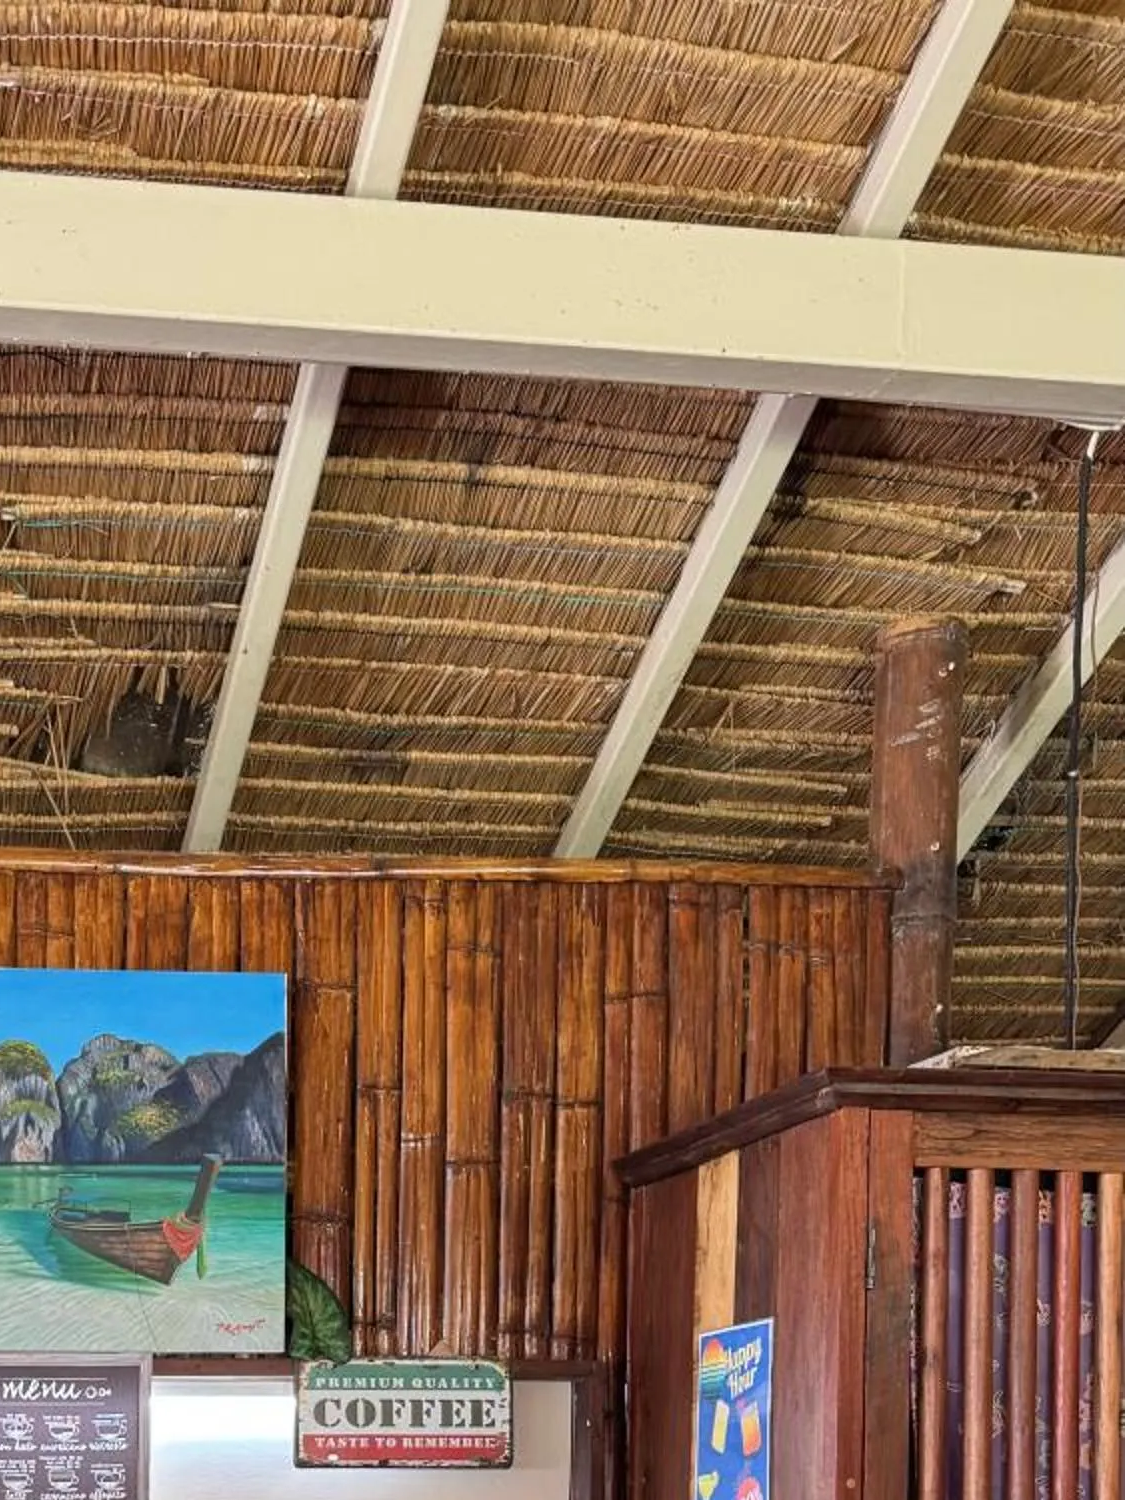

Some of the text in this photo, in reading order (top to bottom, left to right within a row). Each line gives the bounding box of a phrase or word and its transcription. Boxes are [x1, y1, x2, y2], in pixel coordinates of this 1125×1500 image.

[315, 1377, 497, 1390] PREMIUM QUALITY
[312, 1397, 497, 1429] COFFEE
[314, 1437, 369, 1448] TASTE
[375, 1437, 397, 1448] TO
